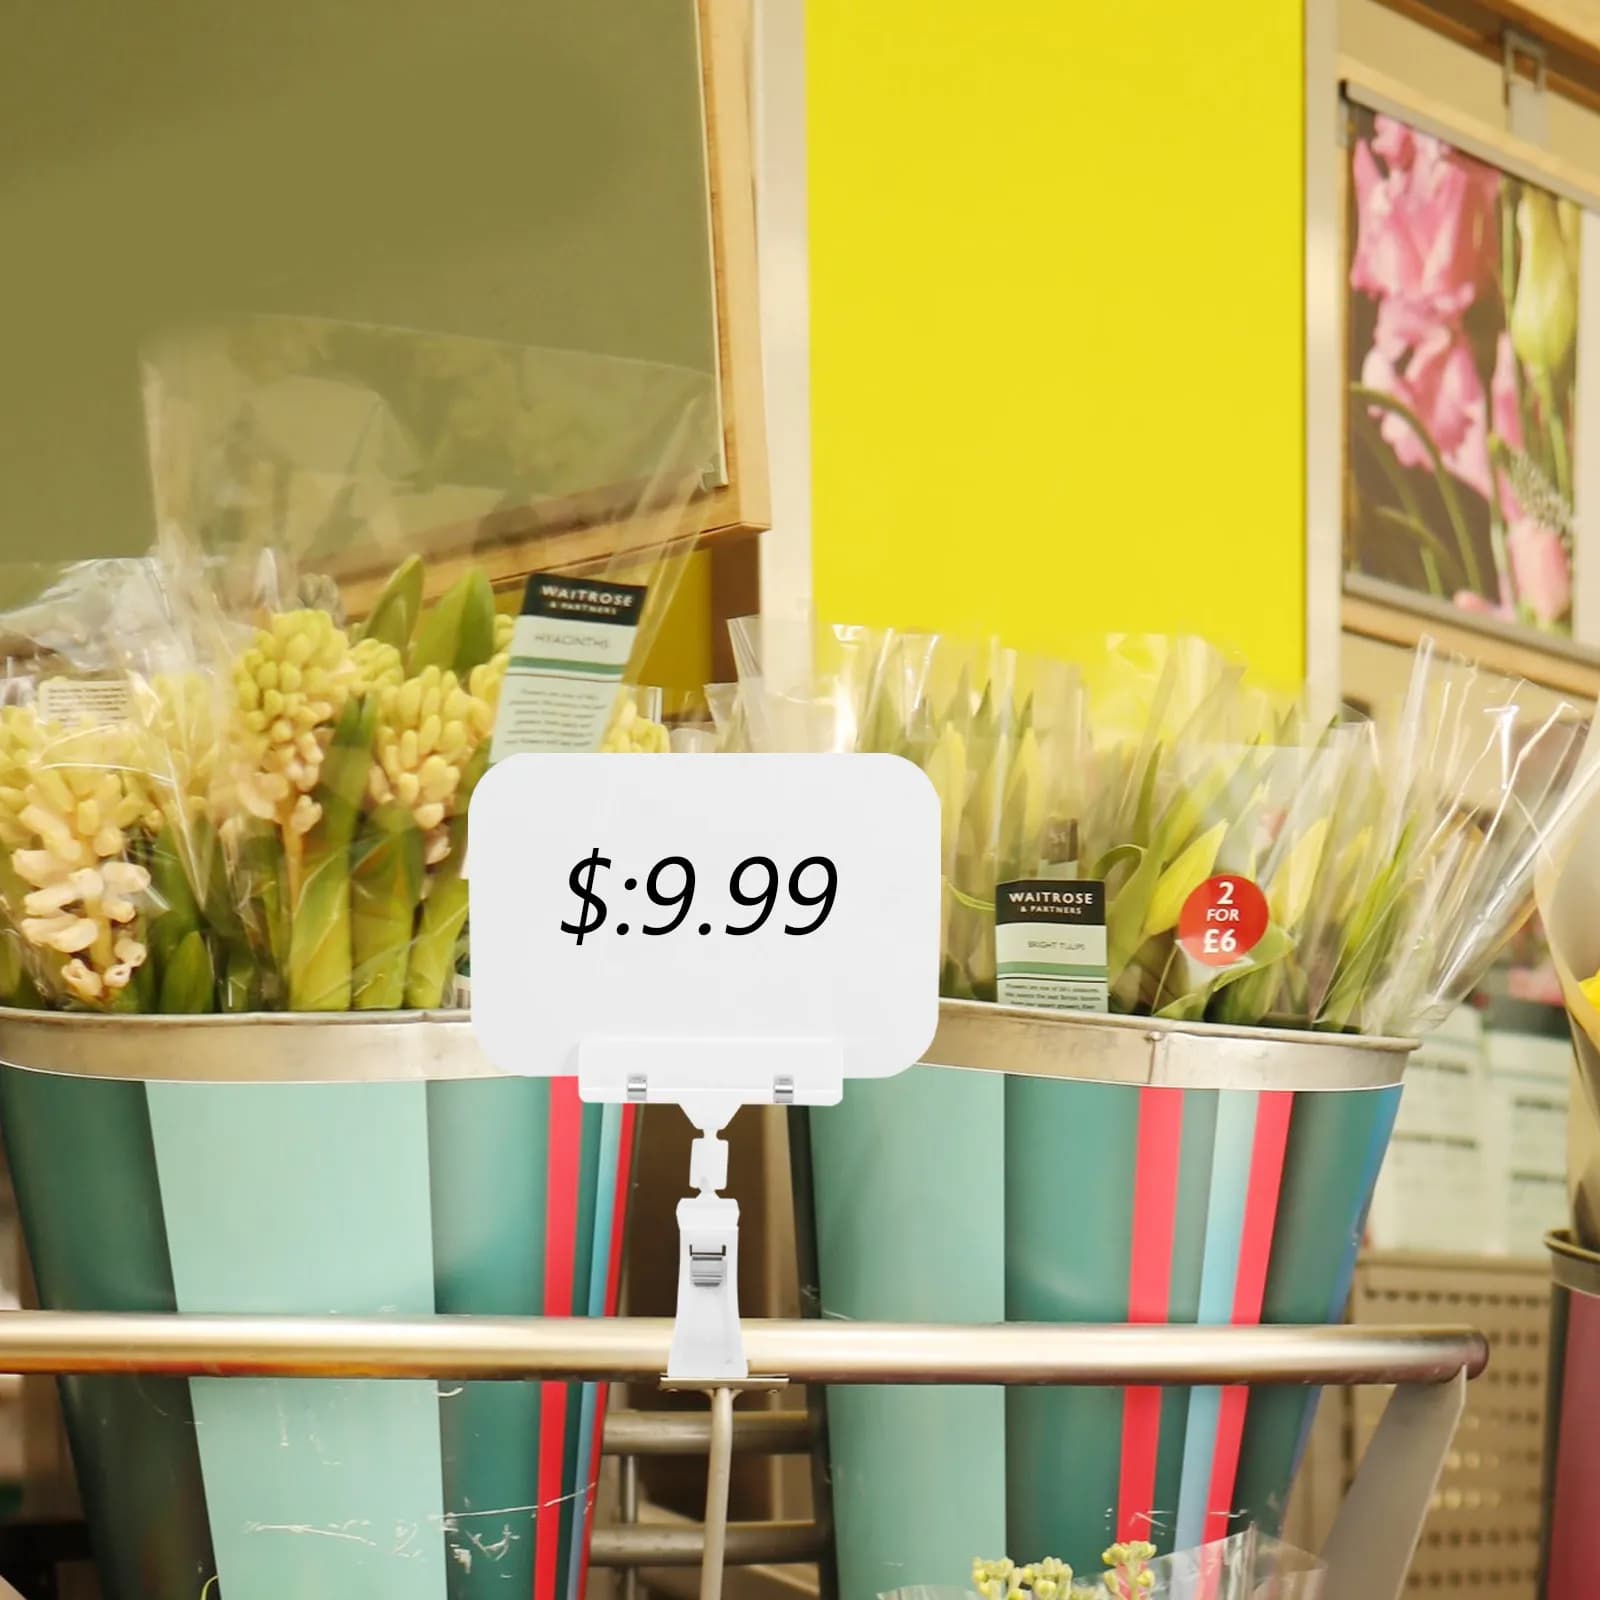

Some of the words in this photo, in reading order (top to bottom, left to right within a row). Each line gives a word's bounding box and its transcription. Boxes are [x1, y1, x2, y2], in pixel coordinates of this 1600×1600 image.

[541, 585, 633, 607] WAITROSE
[560, 602, 618, 616] PARTNERS
[560, 847, 838, 946] $:9.99
[1008, 891, 1094, 905] WAITROSE
[1216, 880, 1235, 905] 2
[1020, 905, 1028, 913] &
[1030, 905, 1083, 915] PARTNERS
[1206, 907, 1241, 922] FOR
[1203, 928, 1237, 954] £6
